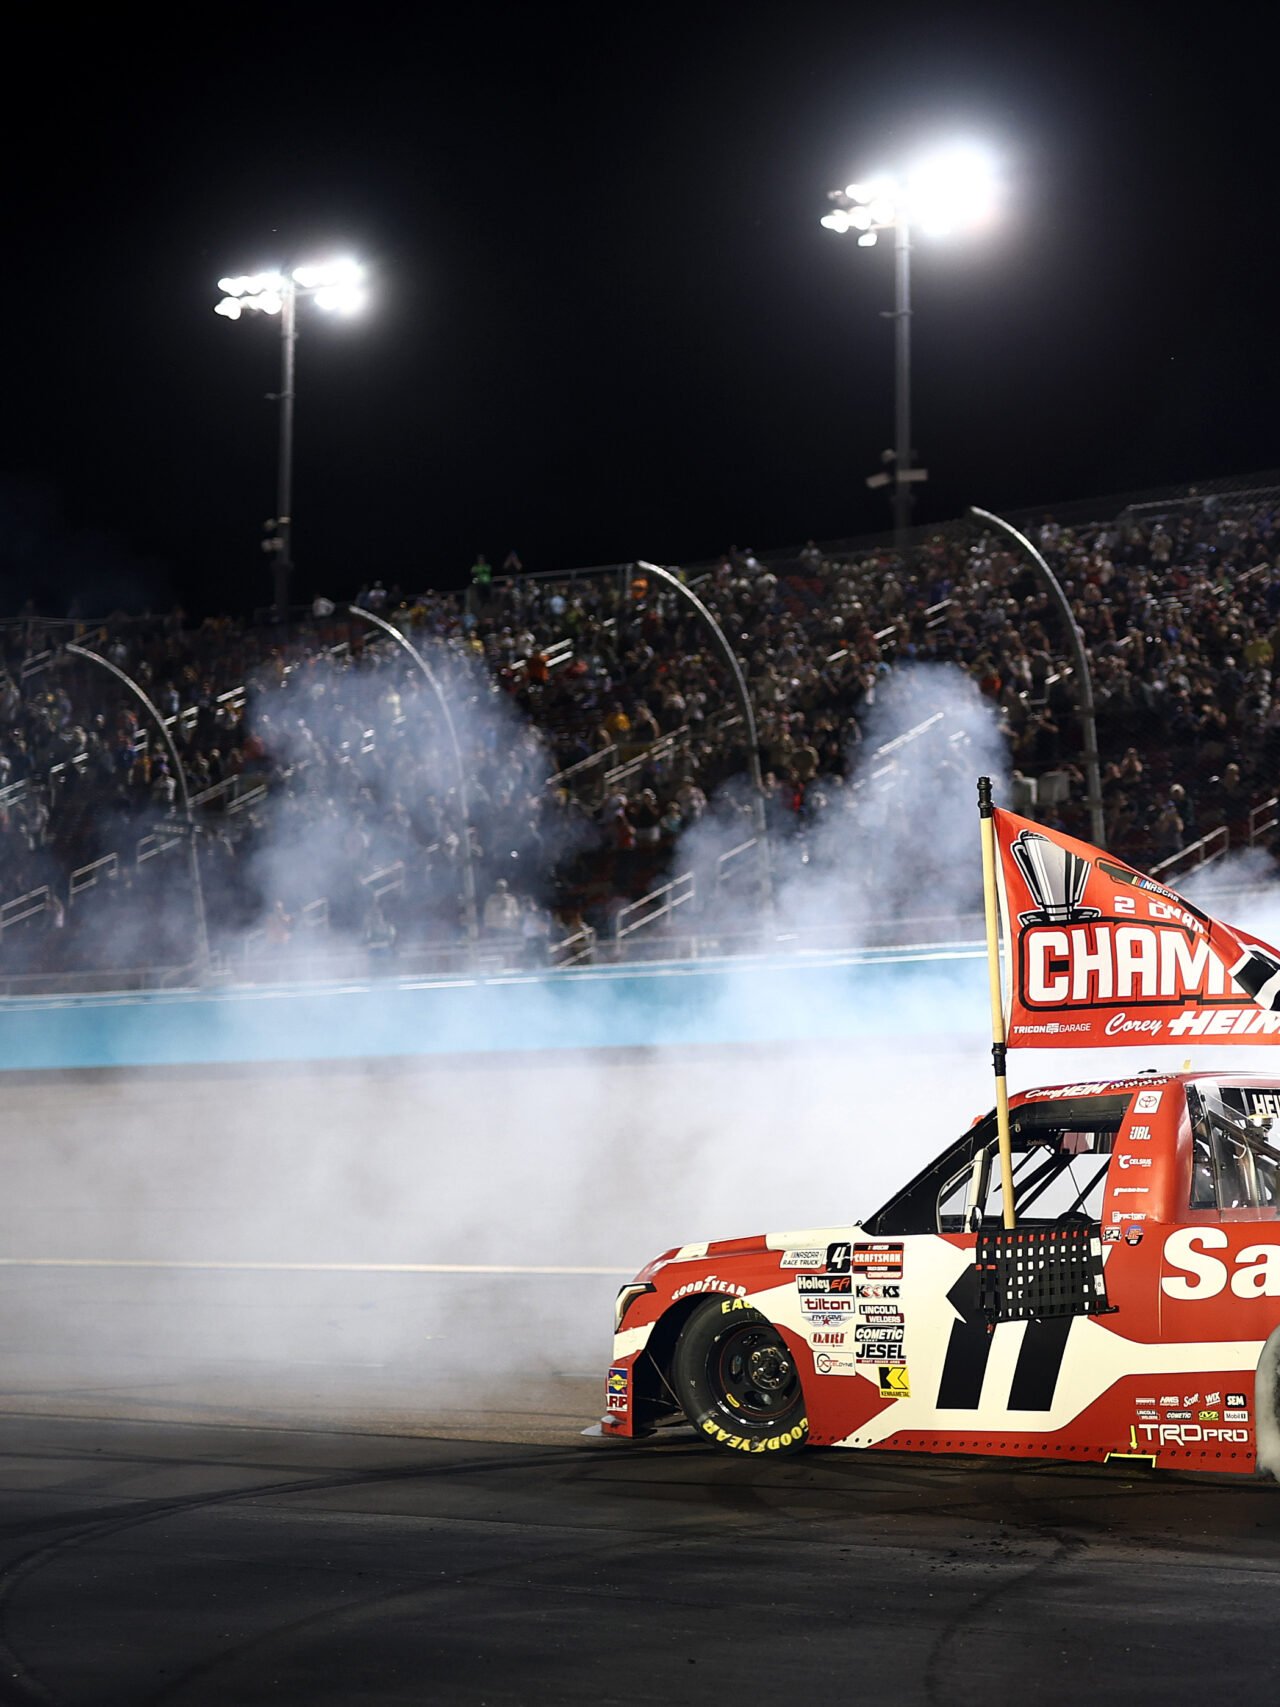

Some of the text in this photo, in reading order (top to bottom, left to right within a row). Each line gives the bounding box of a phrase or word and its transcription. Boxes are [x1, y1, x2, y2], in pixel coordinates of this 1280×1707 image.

[1028, 926, 1253, 1002] CHAM
[1013, 1023, 1091, 1034] TRICON GARAGE
[1105, 1012, 1163, 1036] Corey
[1060, 1083, 1110, 1097] HEIM
[1130, 1126, 1151, 1140] JBL
[795, 1251, 820, 1259] NASCAR
[854, 1253, 902, 1263] CRAFTSMAN
[671, 1275, 748, 1300] GOODYEAR
[798, 1277, 831, 1293] Holley
[804, 1298, 851, 1310] tilton
[860, 1305, 897, 1315] LINCOLN
[868, 1315, 902, 1324] WELDERS
[855, 1327, 904, 1340] COMETIC
[855, 1344, 906, 1359] JESEL
[1205, 1392, 1220, 1404] WIX
[1227, 1395, 1245, 1406] SEM
[702, 1417, 809, 1453] GOODYEAR
